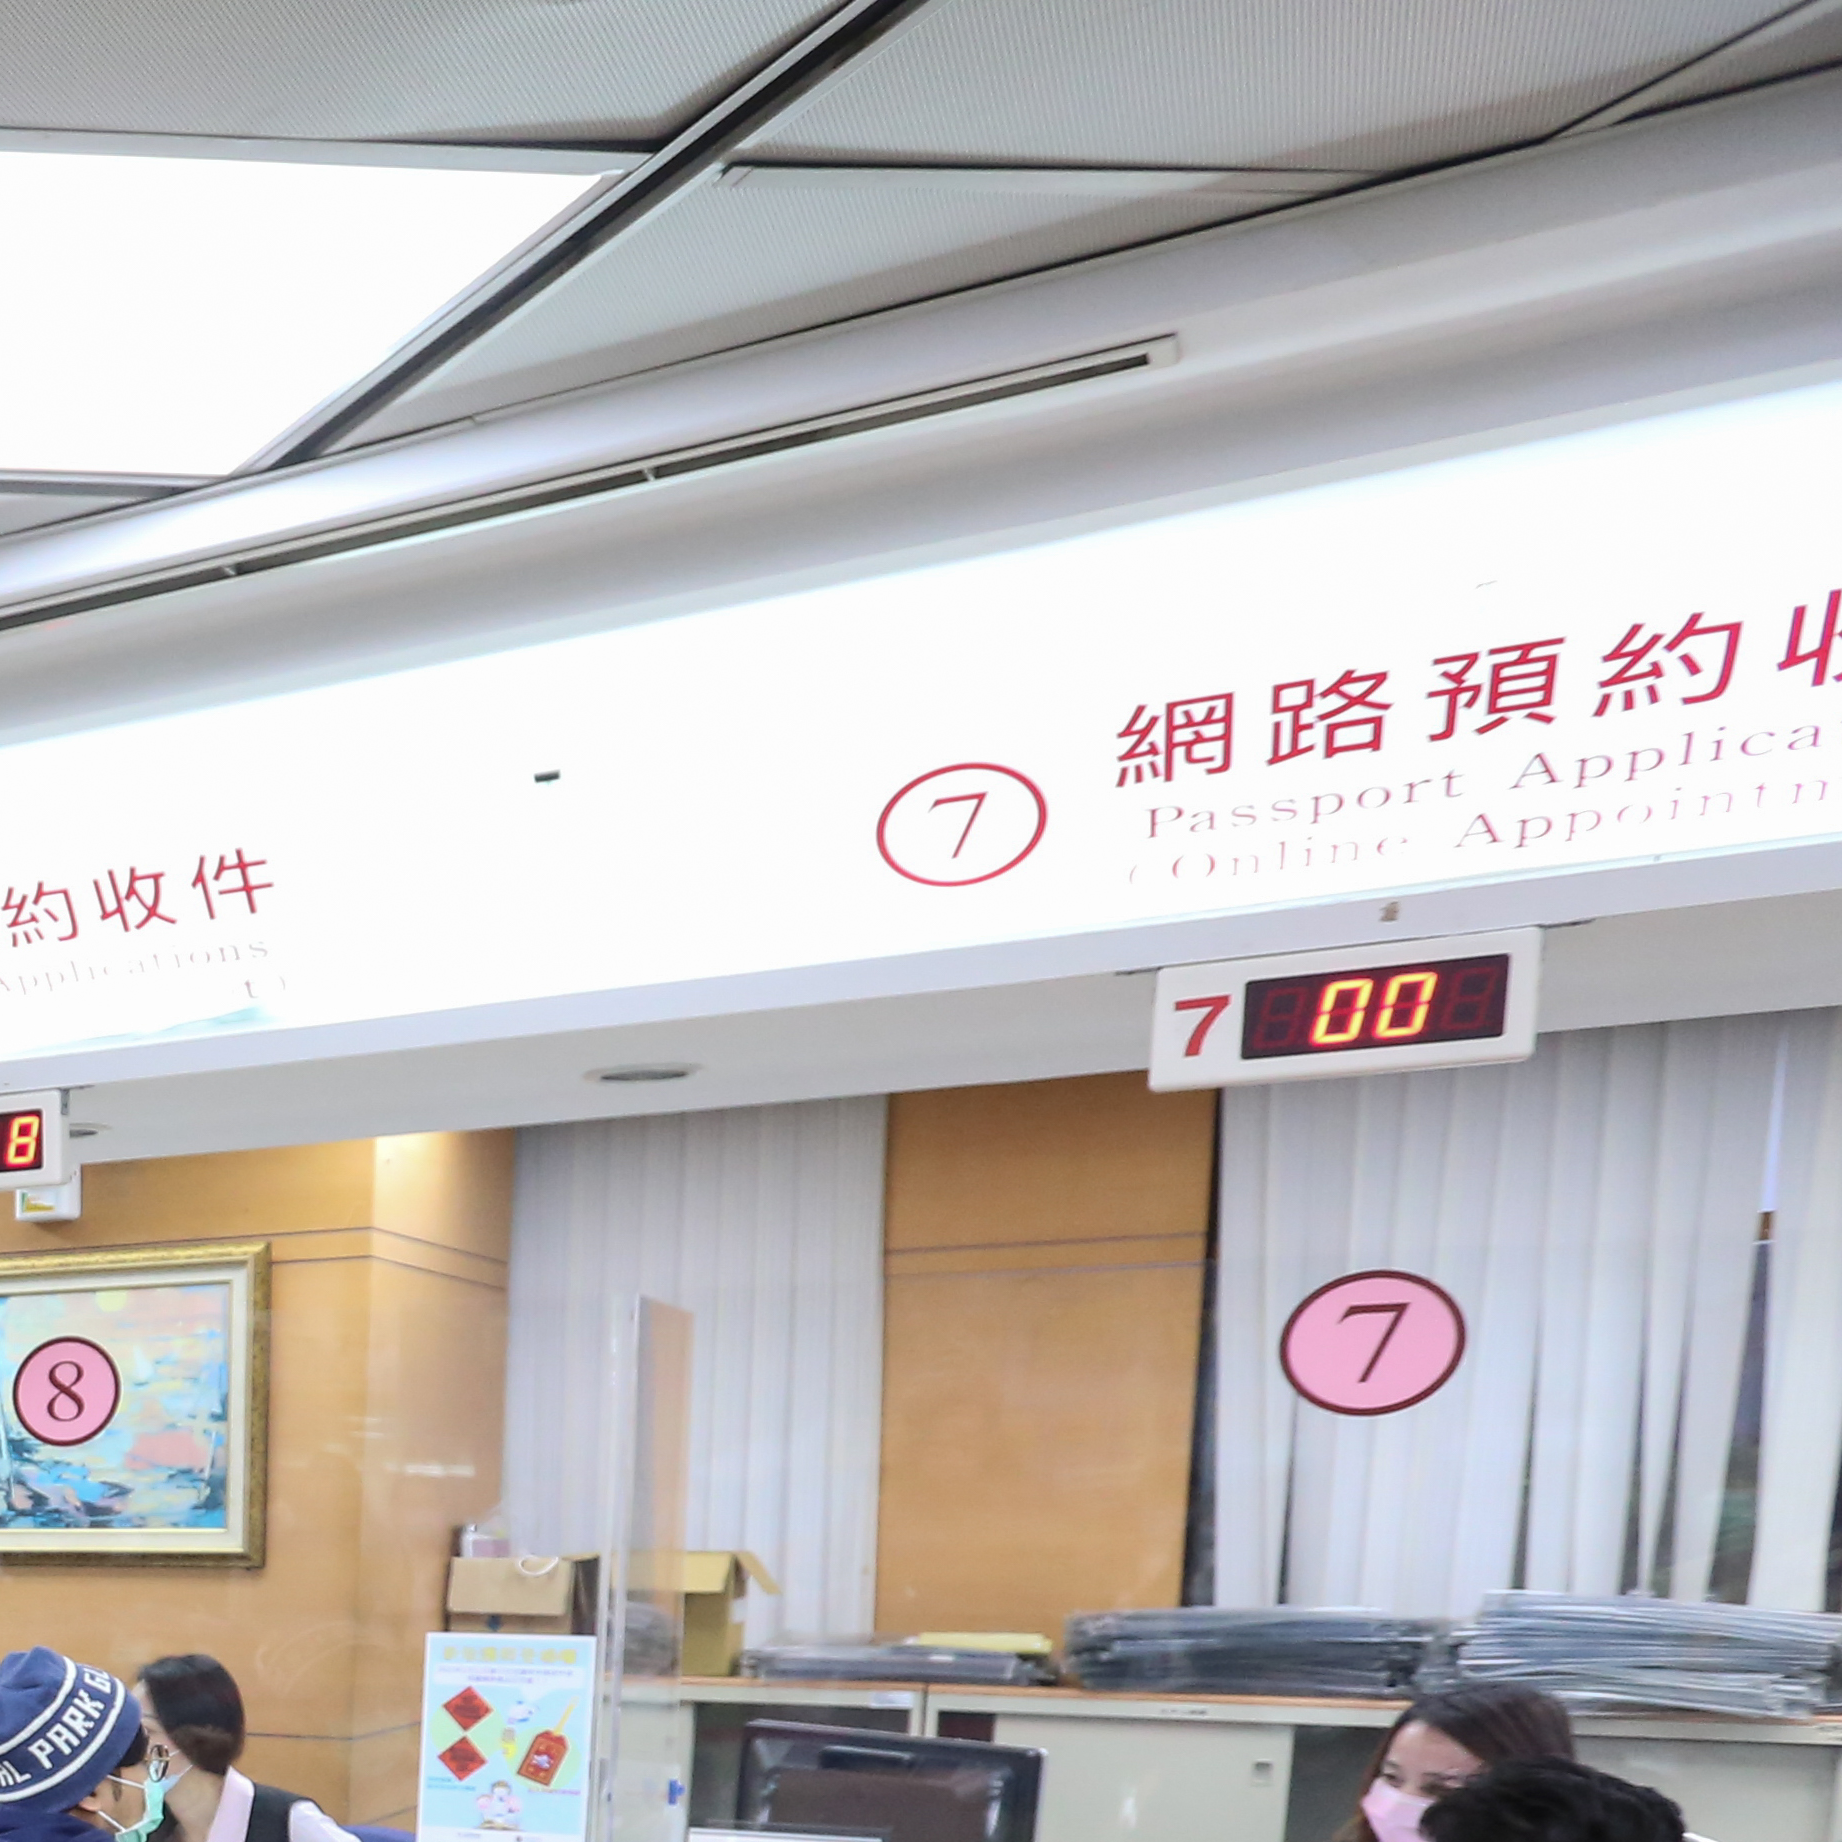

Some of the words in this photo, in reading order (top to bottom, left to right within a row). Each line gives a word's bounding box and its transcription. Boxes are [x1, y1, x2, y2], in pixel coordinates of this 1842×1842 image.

[1147, 768, 1464, 839] Passport
[1509, 722, 1842, 790] Applica
[1172, 994, 1231, 1058] 7
[27, 1689, 106, 1769] PARK
